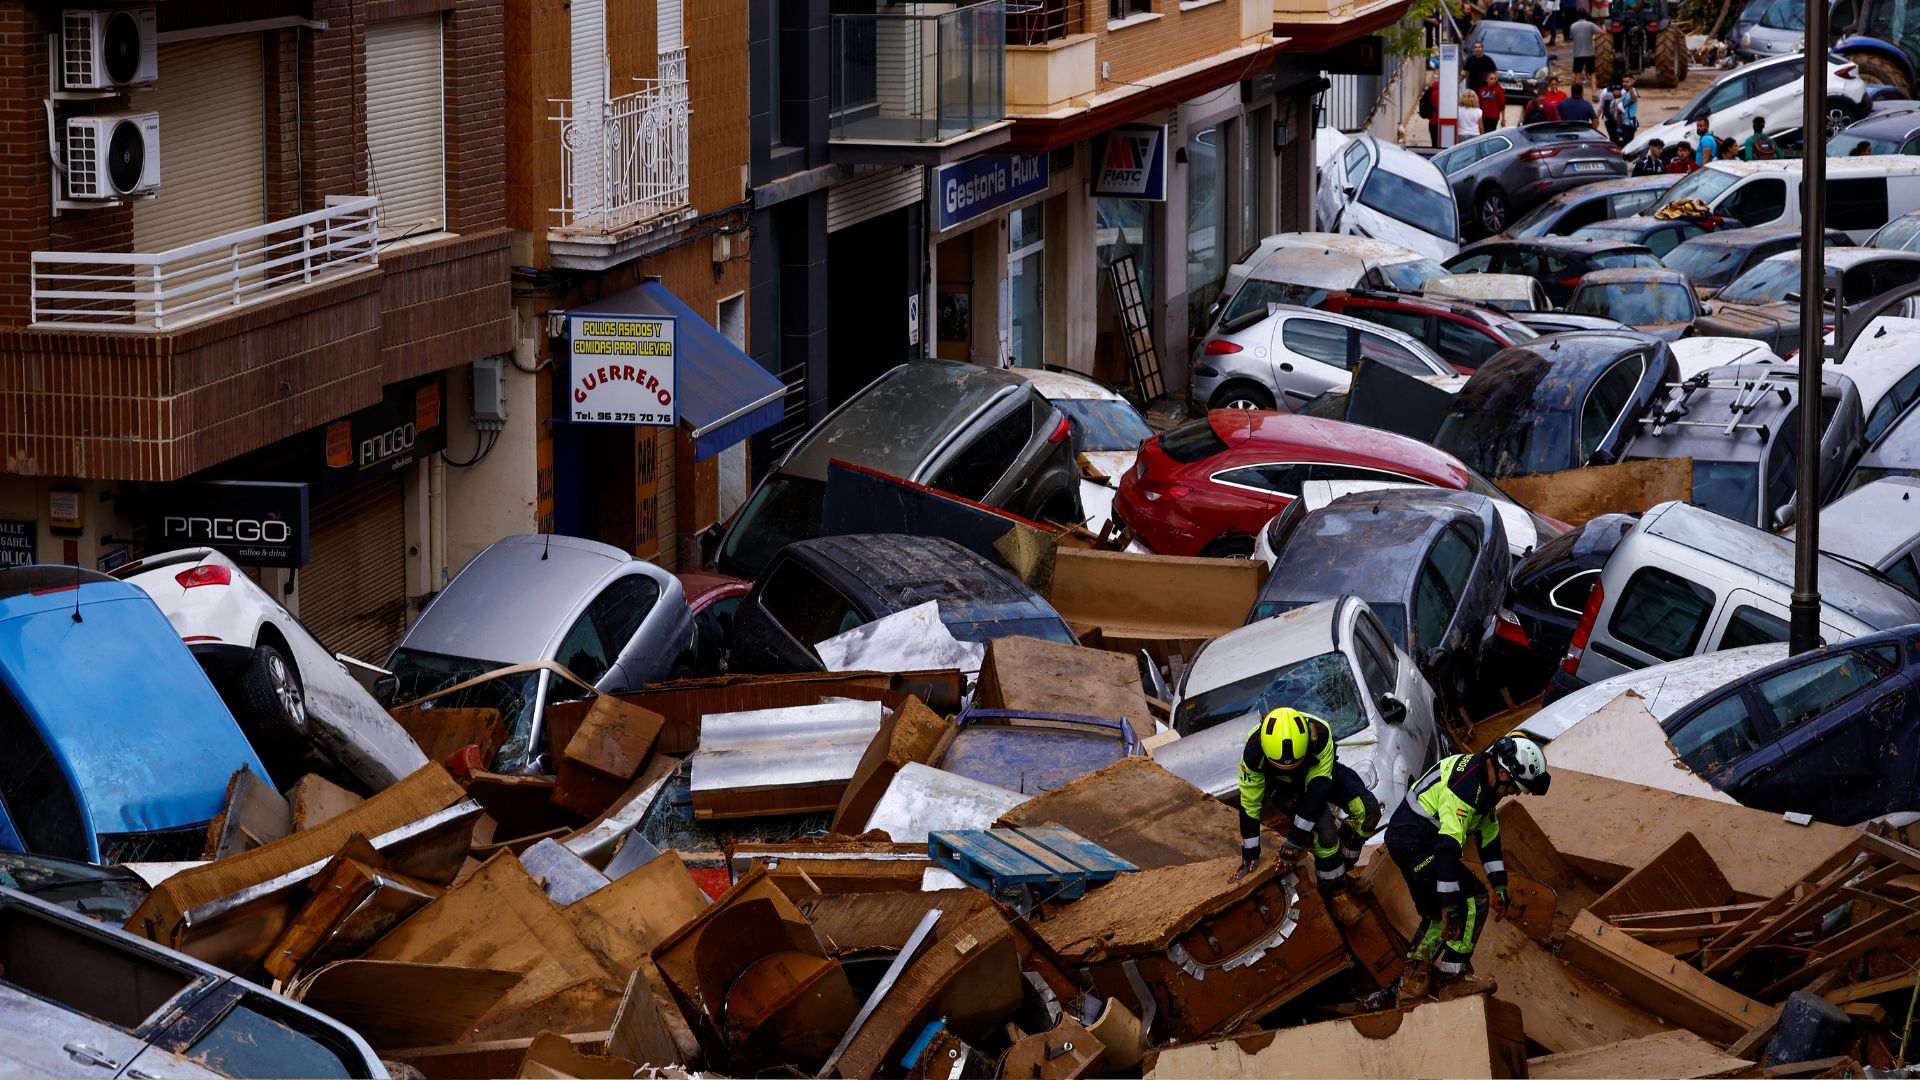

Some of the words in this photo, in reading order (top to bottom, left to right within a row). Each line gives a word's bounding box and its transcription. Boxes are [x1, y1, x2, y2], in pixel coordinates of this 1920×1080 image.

[1103, 170, 1142, 181] FIATC
[946, 162, 1006, 214] Gestoria
[1011, 154, 1040, 188] Ruix
[583, 321, 616, 336] POLLOS
[618, 322, 653, 337] ASADOS
[654, 323, 662, 337] Y
[573, 340, 612, 354] COMIDAS
[613, 341, 637, 355] PARA
[638, 341, 672, 356] LLEVAR
[574, 365, 672, 406] GUERRERO
[575, 411, 594, 420] Tel.
[597, 412, 612, 421] 96
[615, 413, 636, 421] 375
[640, 414, 653, 422] 70
[657, 414, 671, 422] 76
[637, 436, 656, 487] PARA
[0, 522, 25, 535] ALLE
[164, 516, 288, 542] PREGO
[0, 536, 32, 548] SABEL
[0, 547, 33, 566] ÓLICA
[268, 548, 287, 558] drink
[1456, 753, 1474, 772] EROS
